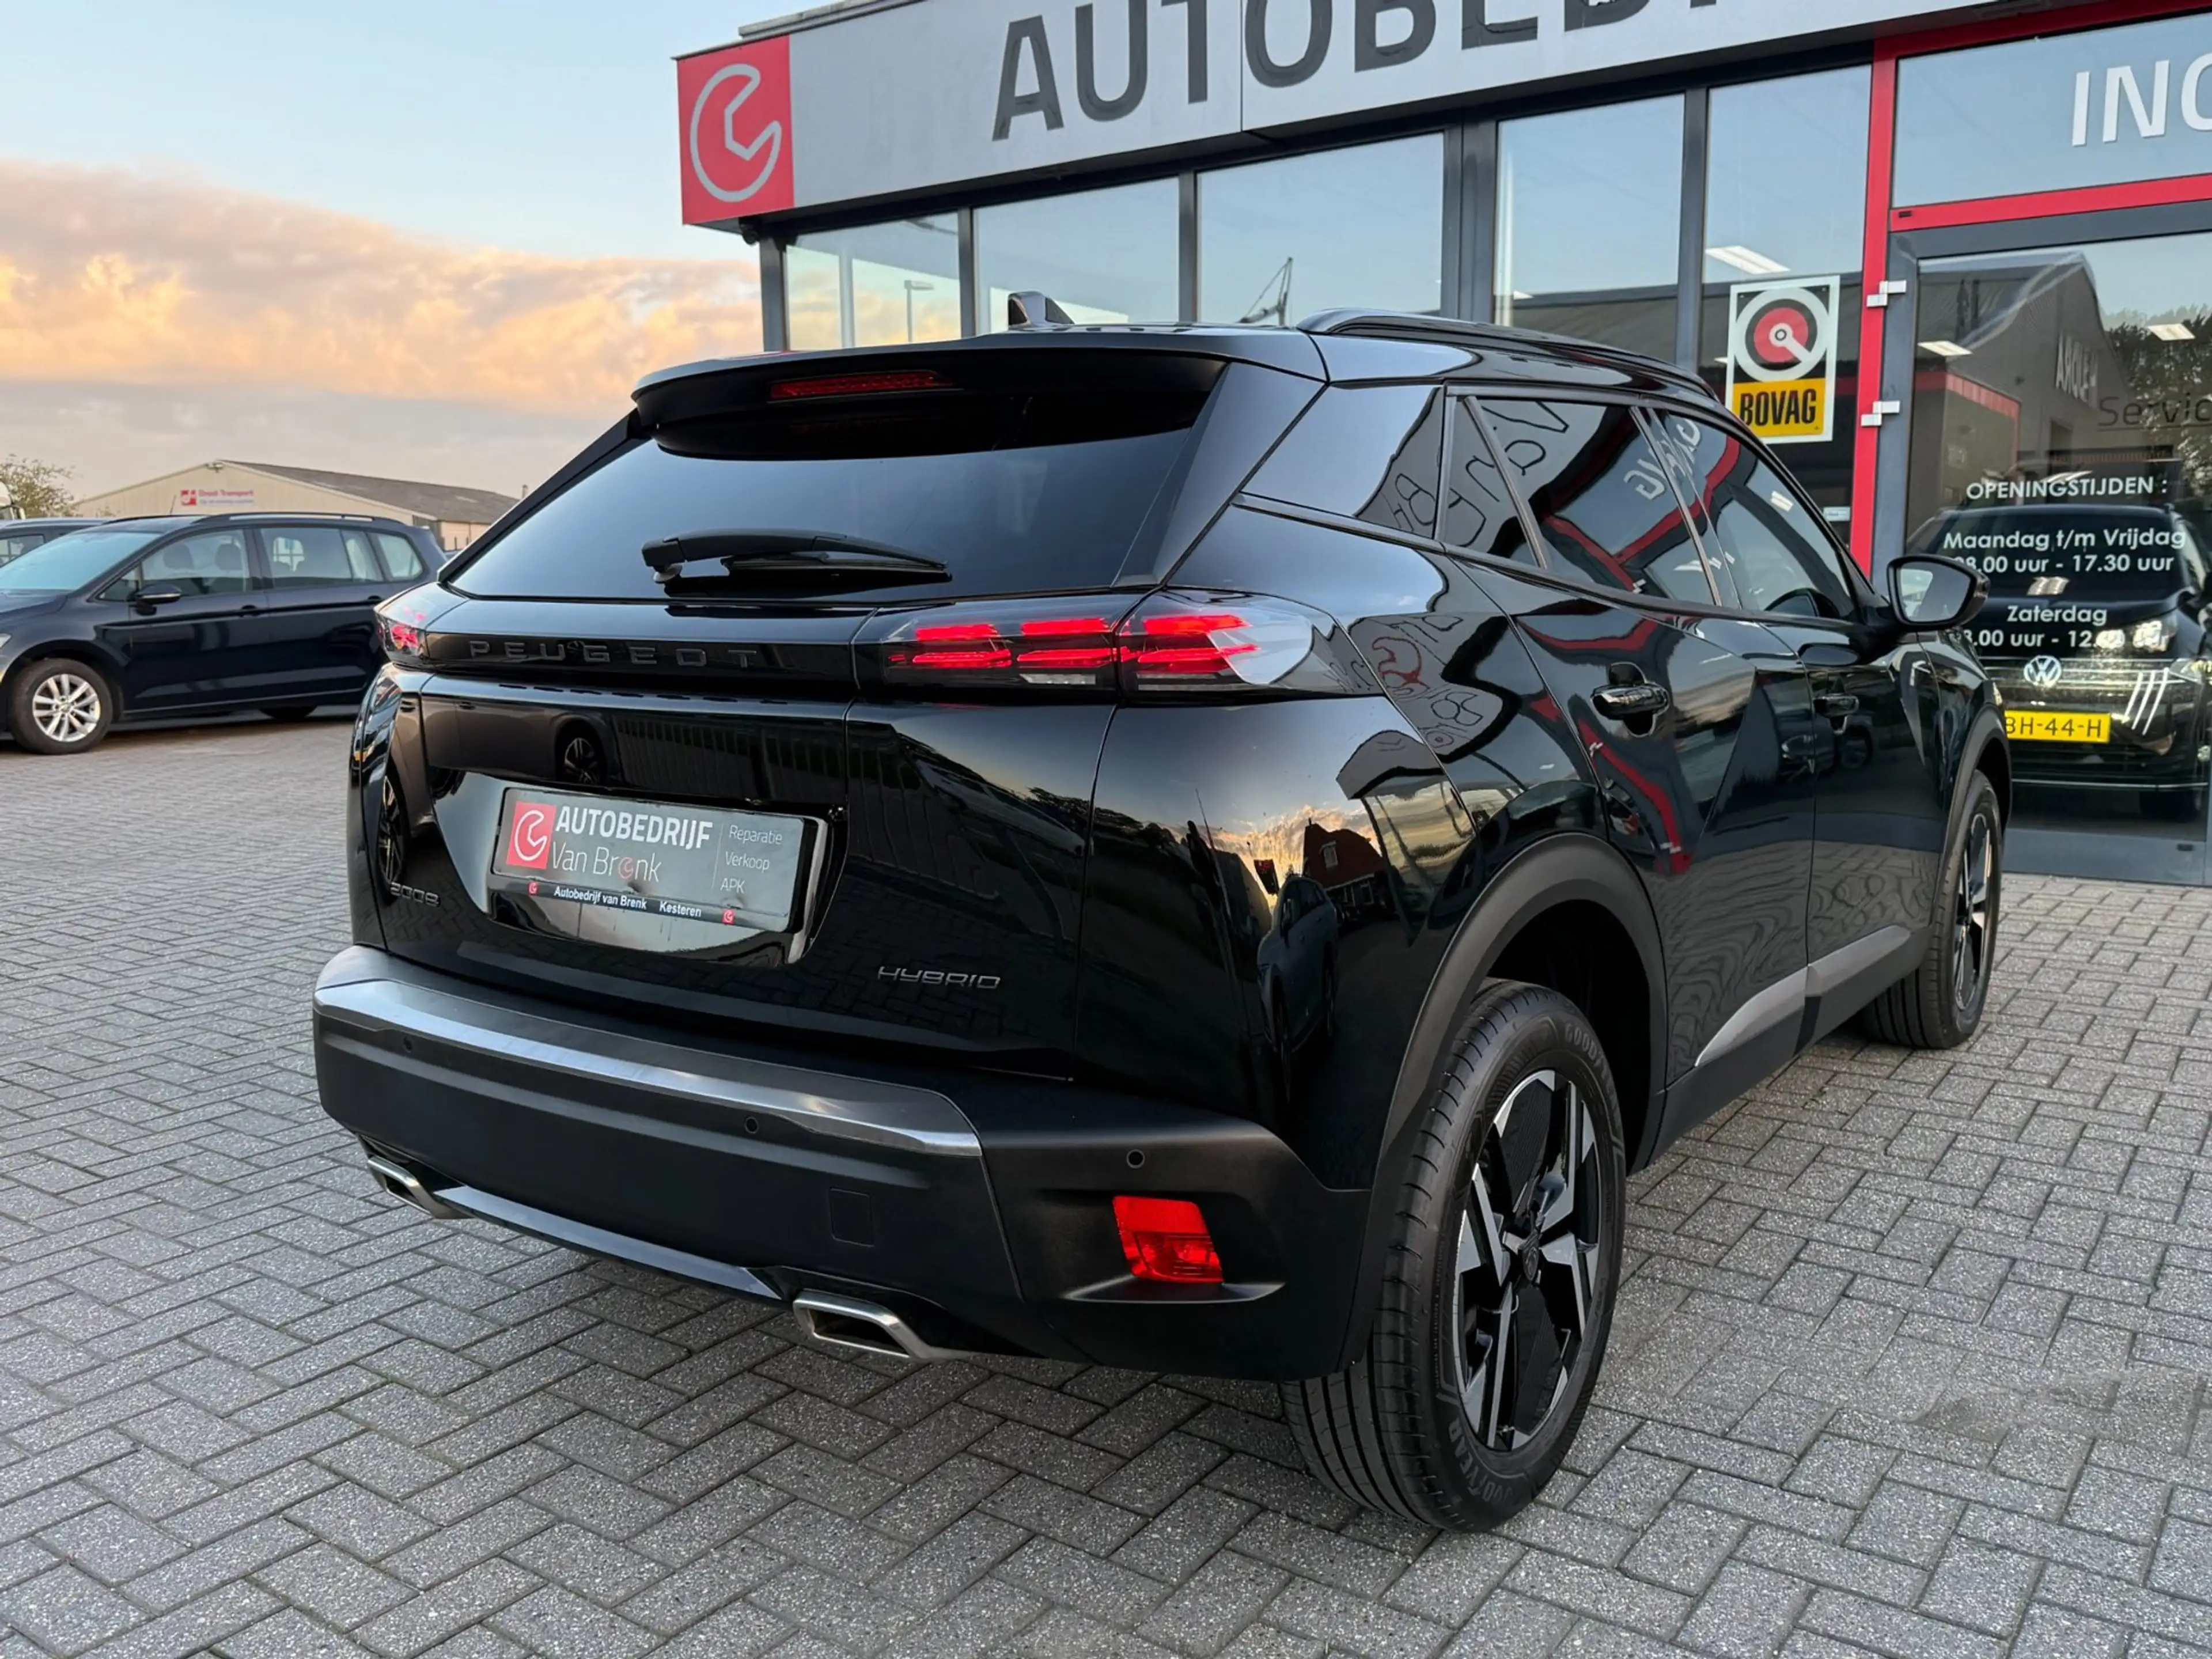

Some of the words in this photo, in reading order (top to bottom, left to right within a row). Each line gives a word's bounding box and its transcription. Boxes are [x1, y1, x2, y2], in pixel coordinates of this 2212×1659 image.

[992, 0, 1717, 142] AUTOB
[1740, 388, 1817, 427] BOVAG
[1965, 476, 2154, 499] OPENINGSTIJDEN
[1943, 531, 2050, 551] Maandag
[2055, 529, 2096, 550] t/m
[2103, 527, 2186, 549] Vrijdag
[1953, 556, 2008, 573] 8.00
[2015, 559, 2049, 573] uur
[2073, 554, 2130, 572] 17.30
[2137, 557, 2174, 571] uur
[2007, 605, 2108, 626] Zaterdag
[2010, 632, 2044, 646] uur
[2069, 630, 2126, 649] 12.
[468, 639, 757, 669] PEUGEOT
[554, 806, 713, 850] AUTOBEDRIJF
[729, 825, 782, 844] Reparatie
[552, 841, 588, 873] Van
[725, 851, 770, 873] Verkoop
[390, 881, 440, 907] 2008
[720, 878, 745, 893] APK
[554, 885, 600, 905] Autobedrijf
[602, 896, 618, 906] van
[620, 895, 647, 910] Brenk
[660, 900, 701, 917] Kesteren
[877, 966, 1001, 989] HYBRID
[1448, 1417, 1516, 1506] OODYEAR
